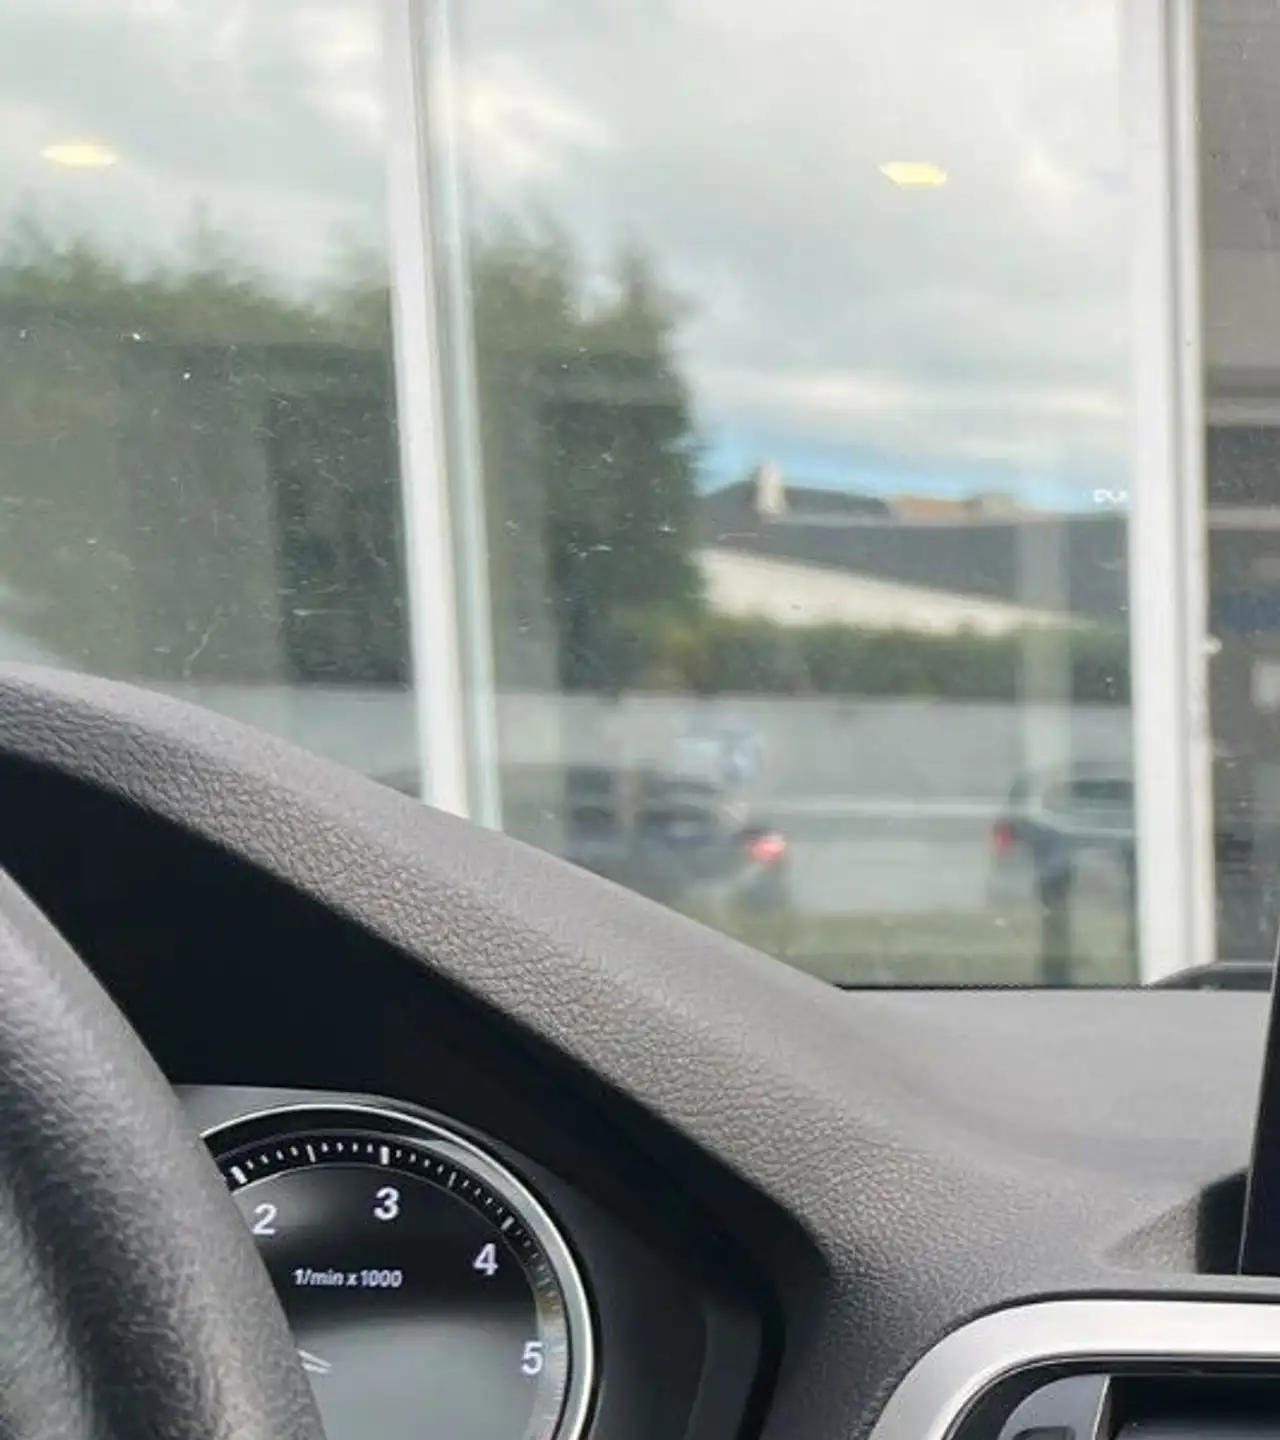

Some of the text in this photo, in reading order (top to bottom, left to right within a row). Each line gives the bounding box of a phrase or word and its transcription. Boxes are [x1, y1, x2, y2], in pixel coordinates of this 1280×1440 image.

[252, 1202, 278, 1236] 2
[373, 1186, 401, 1221] 3
[472, 1242, 500, 1276] 4
[293, 1268, 343, 1287] 1/min
[360, 1269, 403, 1288] 1000
[520, 1340, 545, 1376] 5
